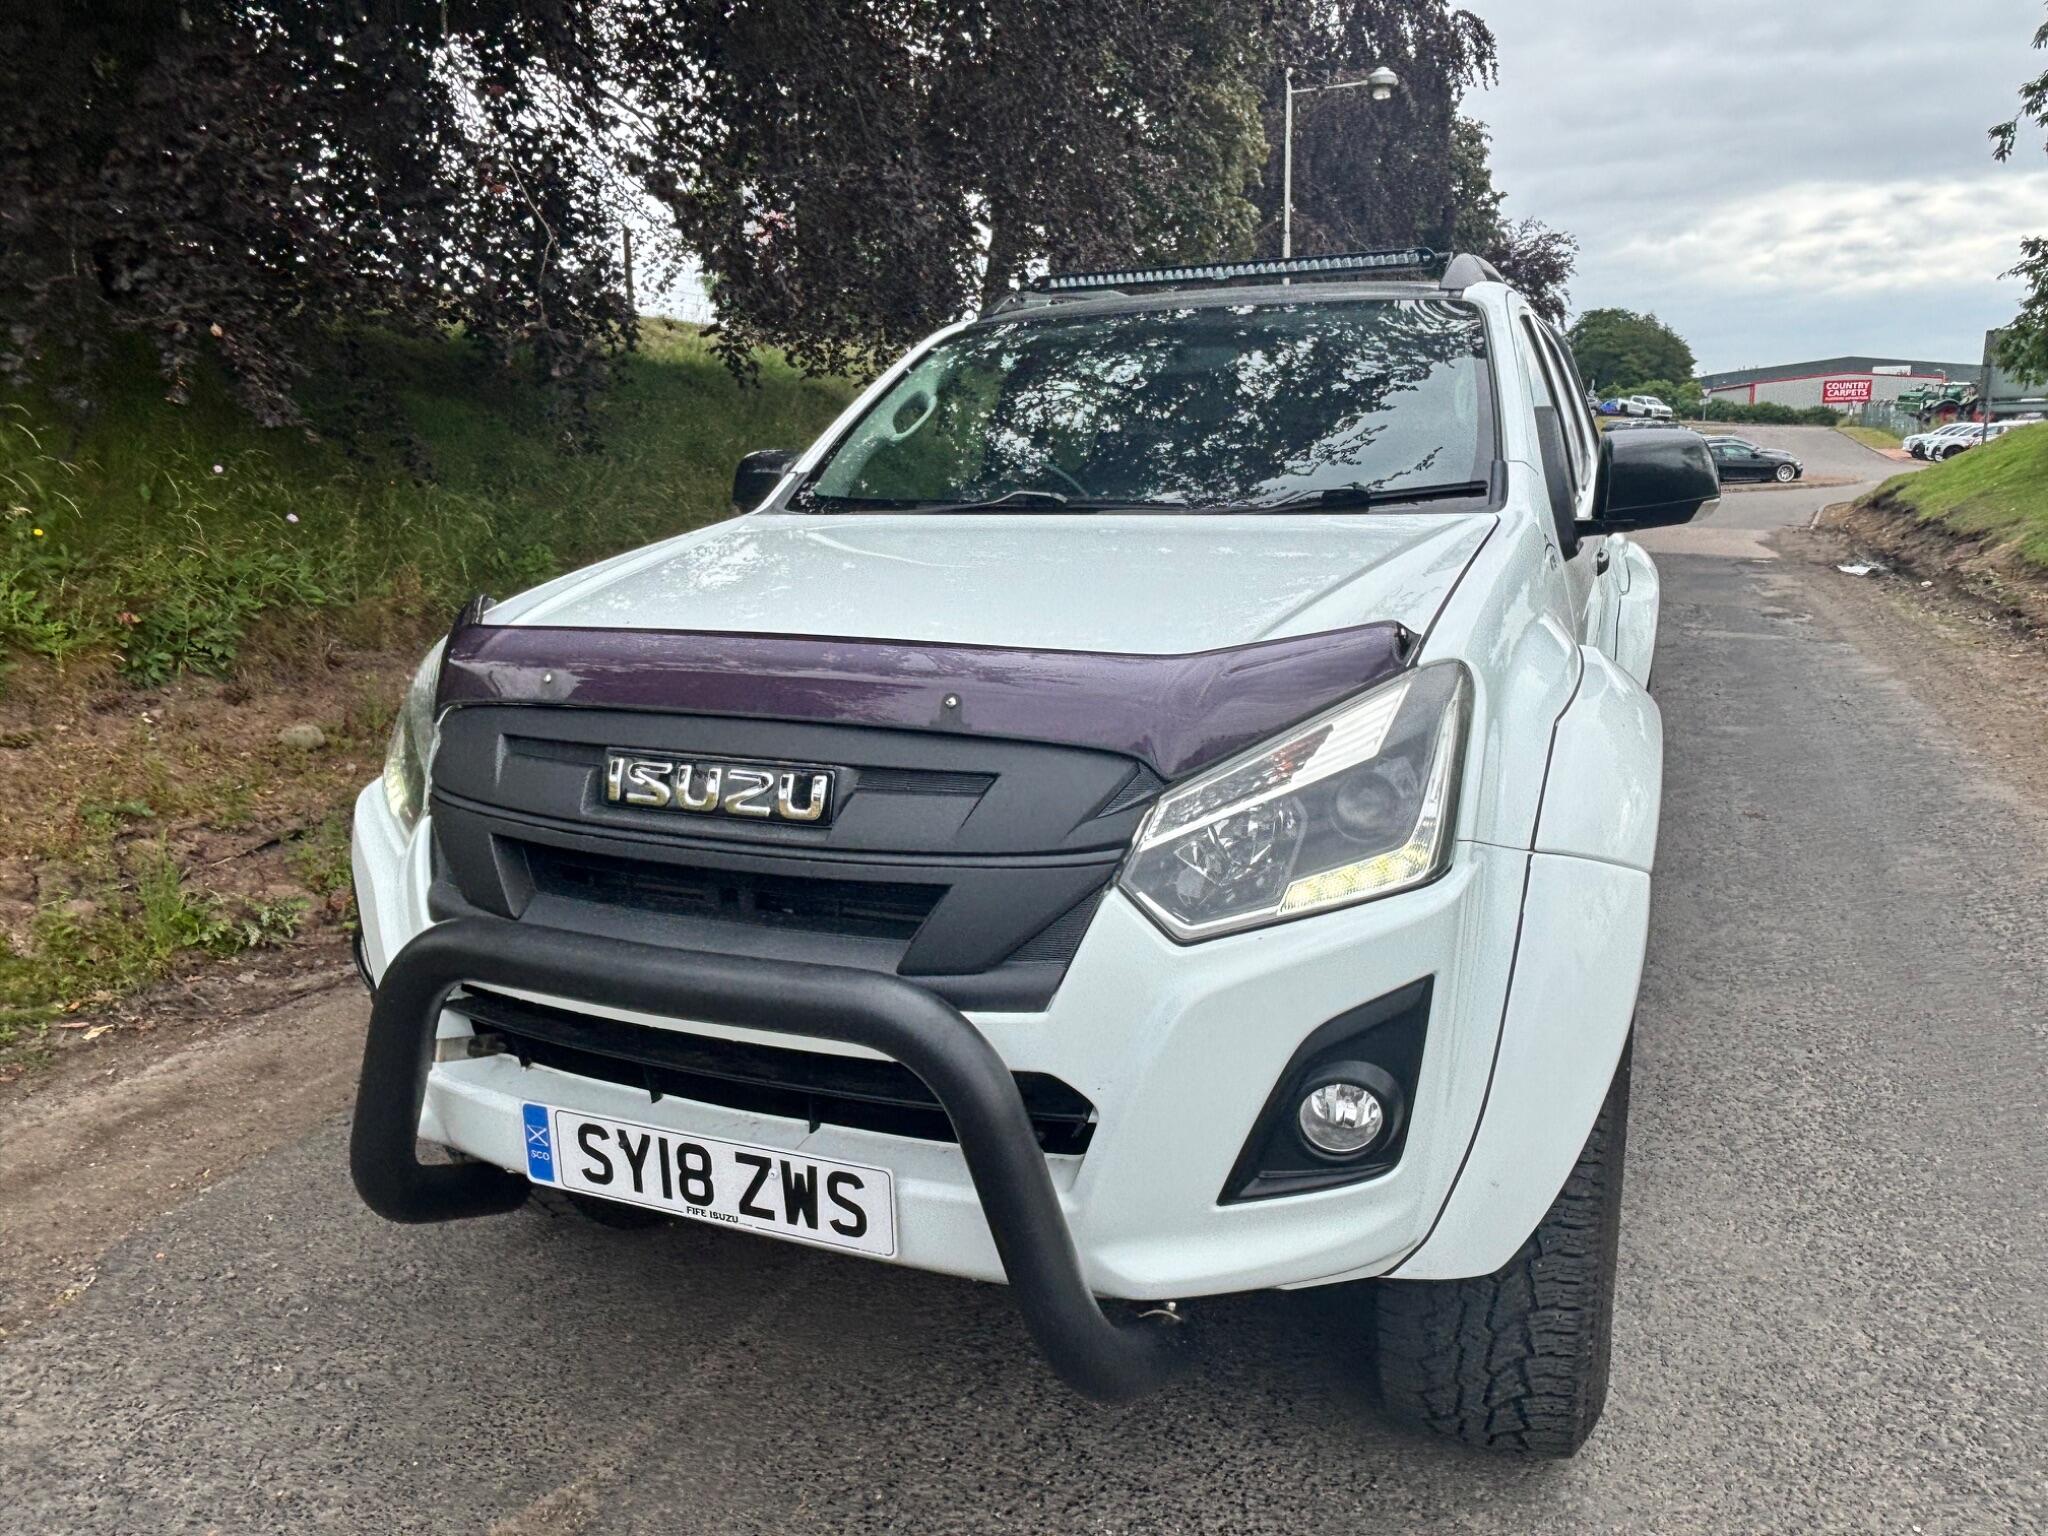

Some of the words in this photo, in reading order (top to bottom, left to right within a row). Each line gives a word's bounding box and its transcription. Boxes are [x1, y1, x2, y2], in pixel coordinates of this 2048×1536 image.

[1827, 389, 1868, 397] CARPETS
[608, 757, 827, 821] ISUZU
[530, 1150, 551, 1162] SCO
[577, 1122, 715, 1206] SY18
[735, 1151, 867, 1238] ZWS
[686, 1206, 707, 1218] FIFE
[709, 1210, 739, 1224] ISUZU
